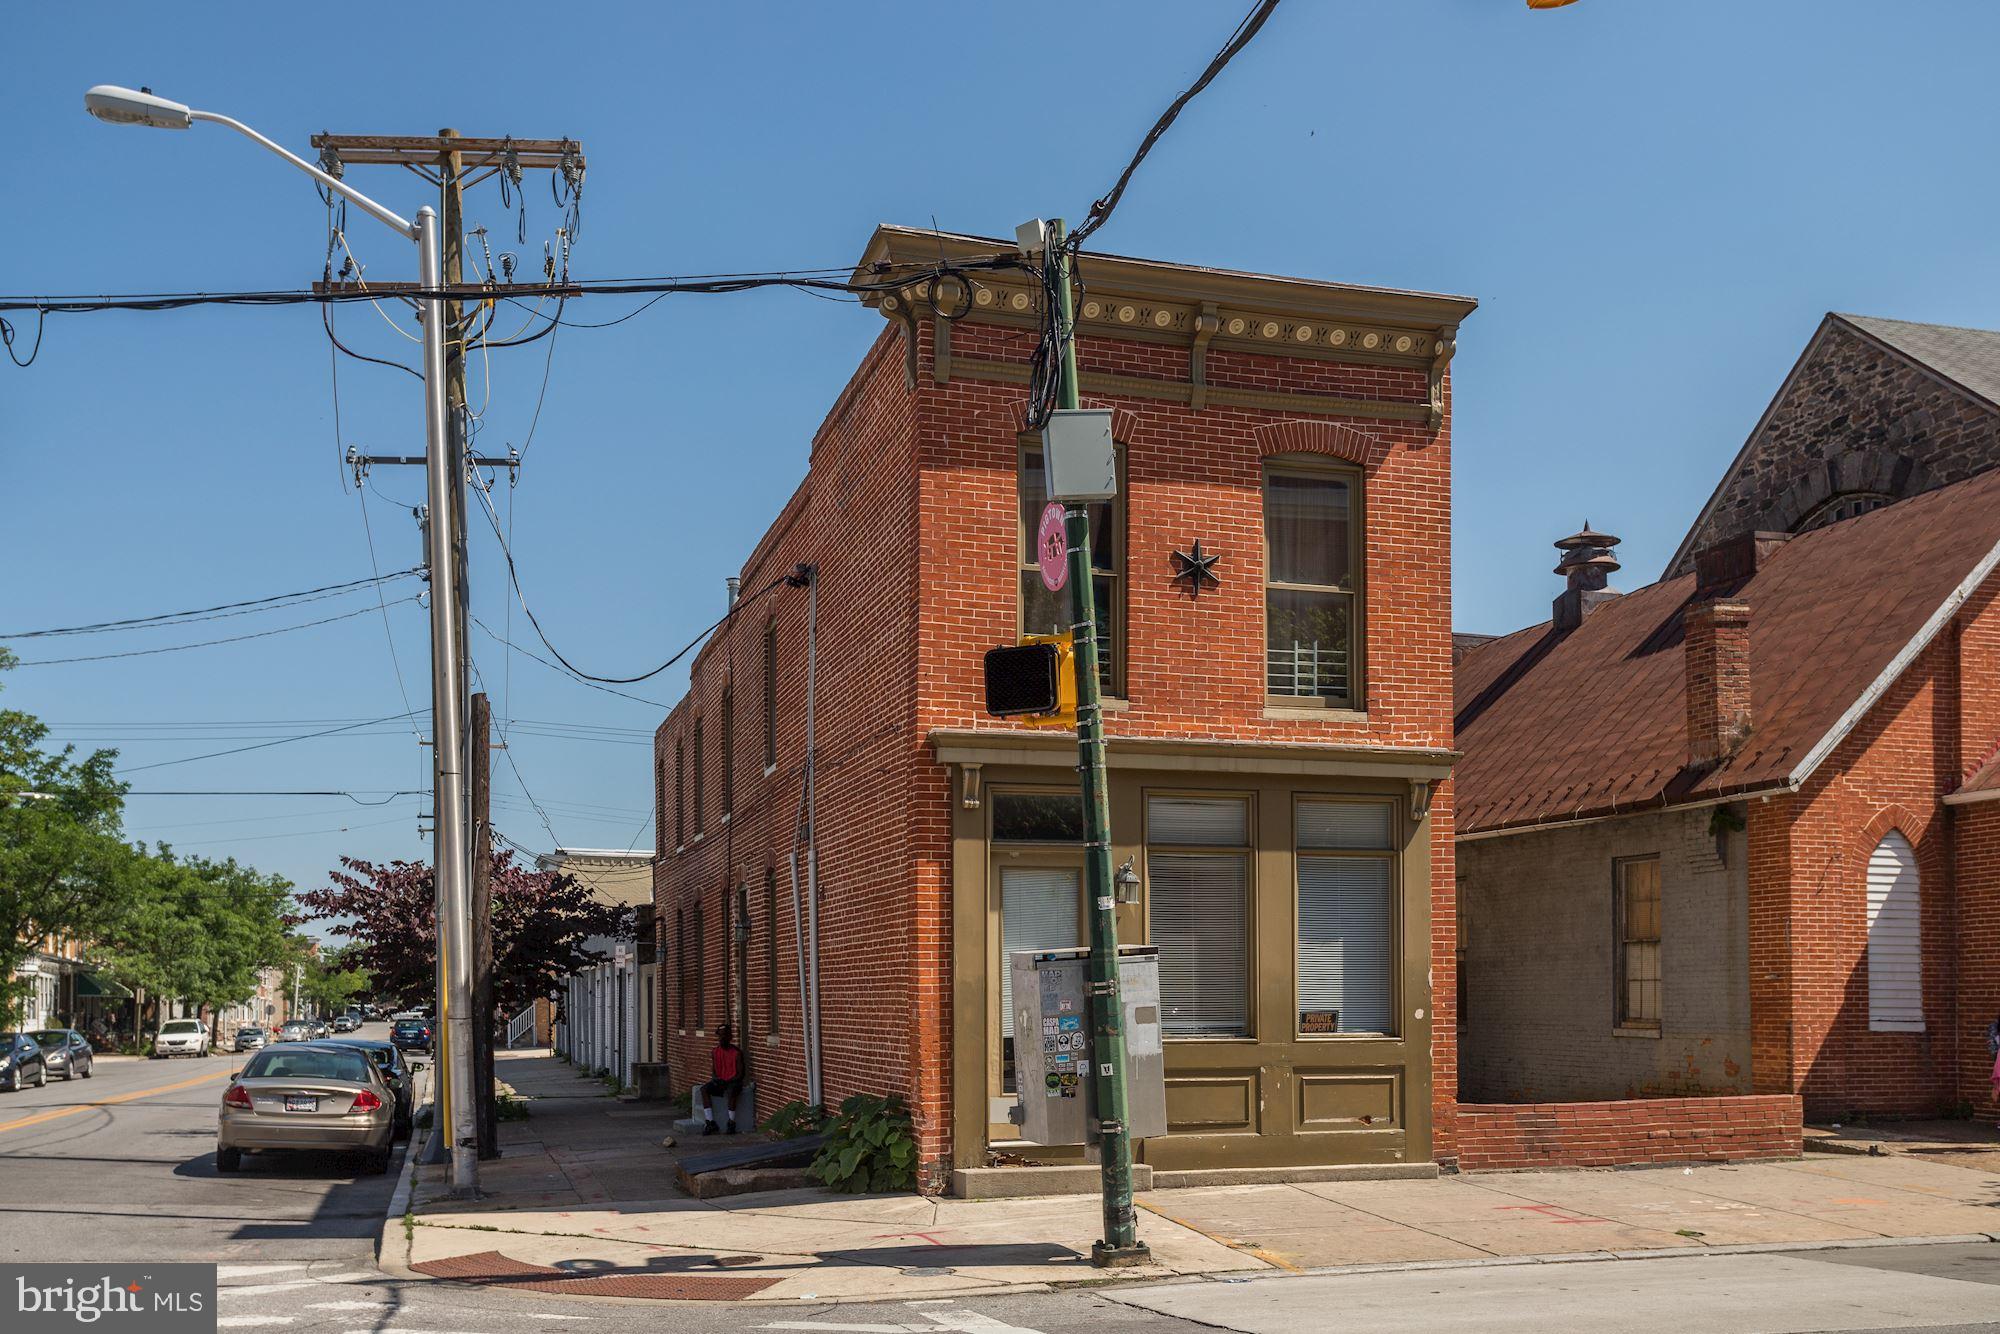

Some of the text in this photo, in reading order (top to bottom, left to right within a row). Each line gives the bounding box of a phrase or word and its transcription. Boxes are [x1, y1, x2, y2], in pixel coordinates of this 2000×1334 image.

[1041, 508, 1065, 536] PIGTOWN
[1306, 1013, 1332, 1022] PRIVATE
[1301, 1022, 1336, 1032] PROPERTY
